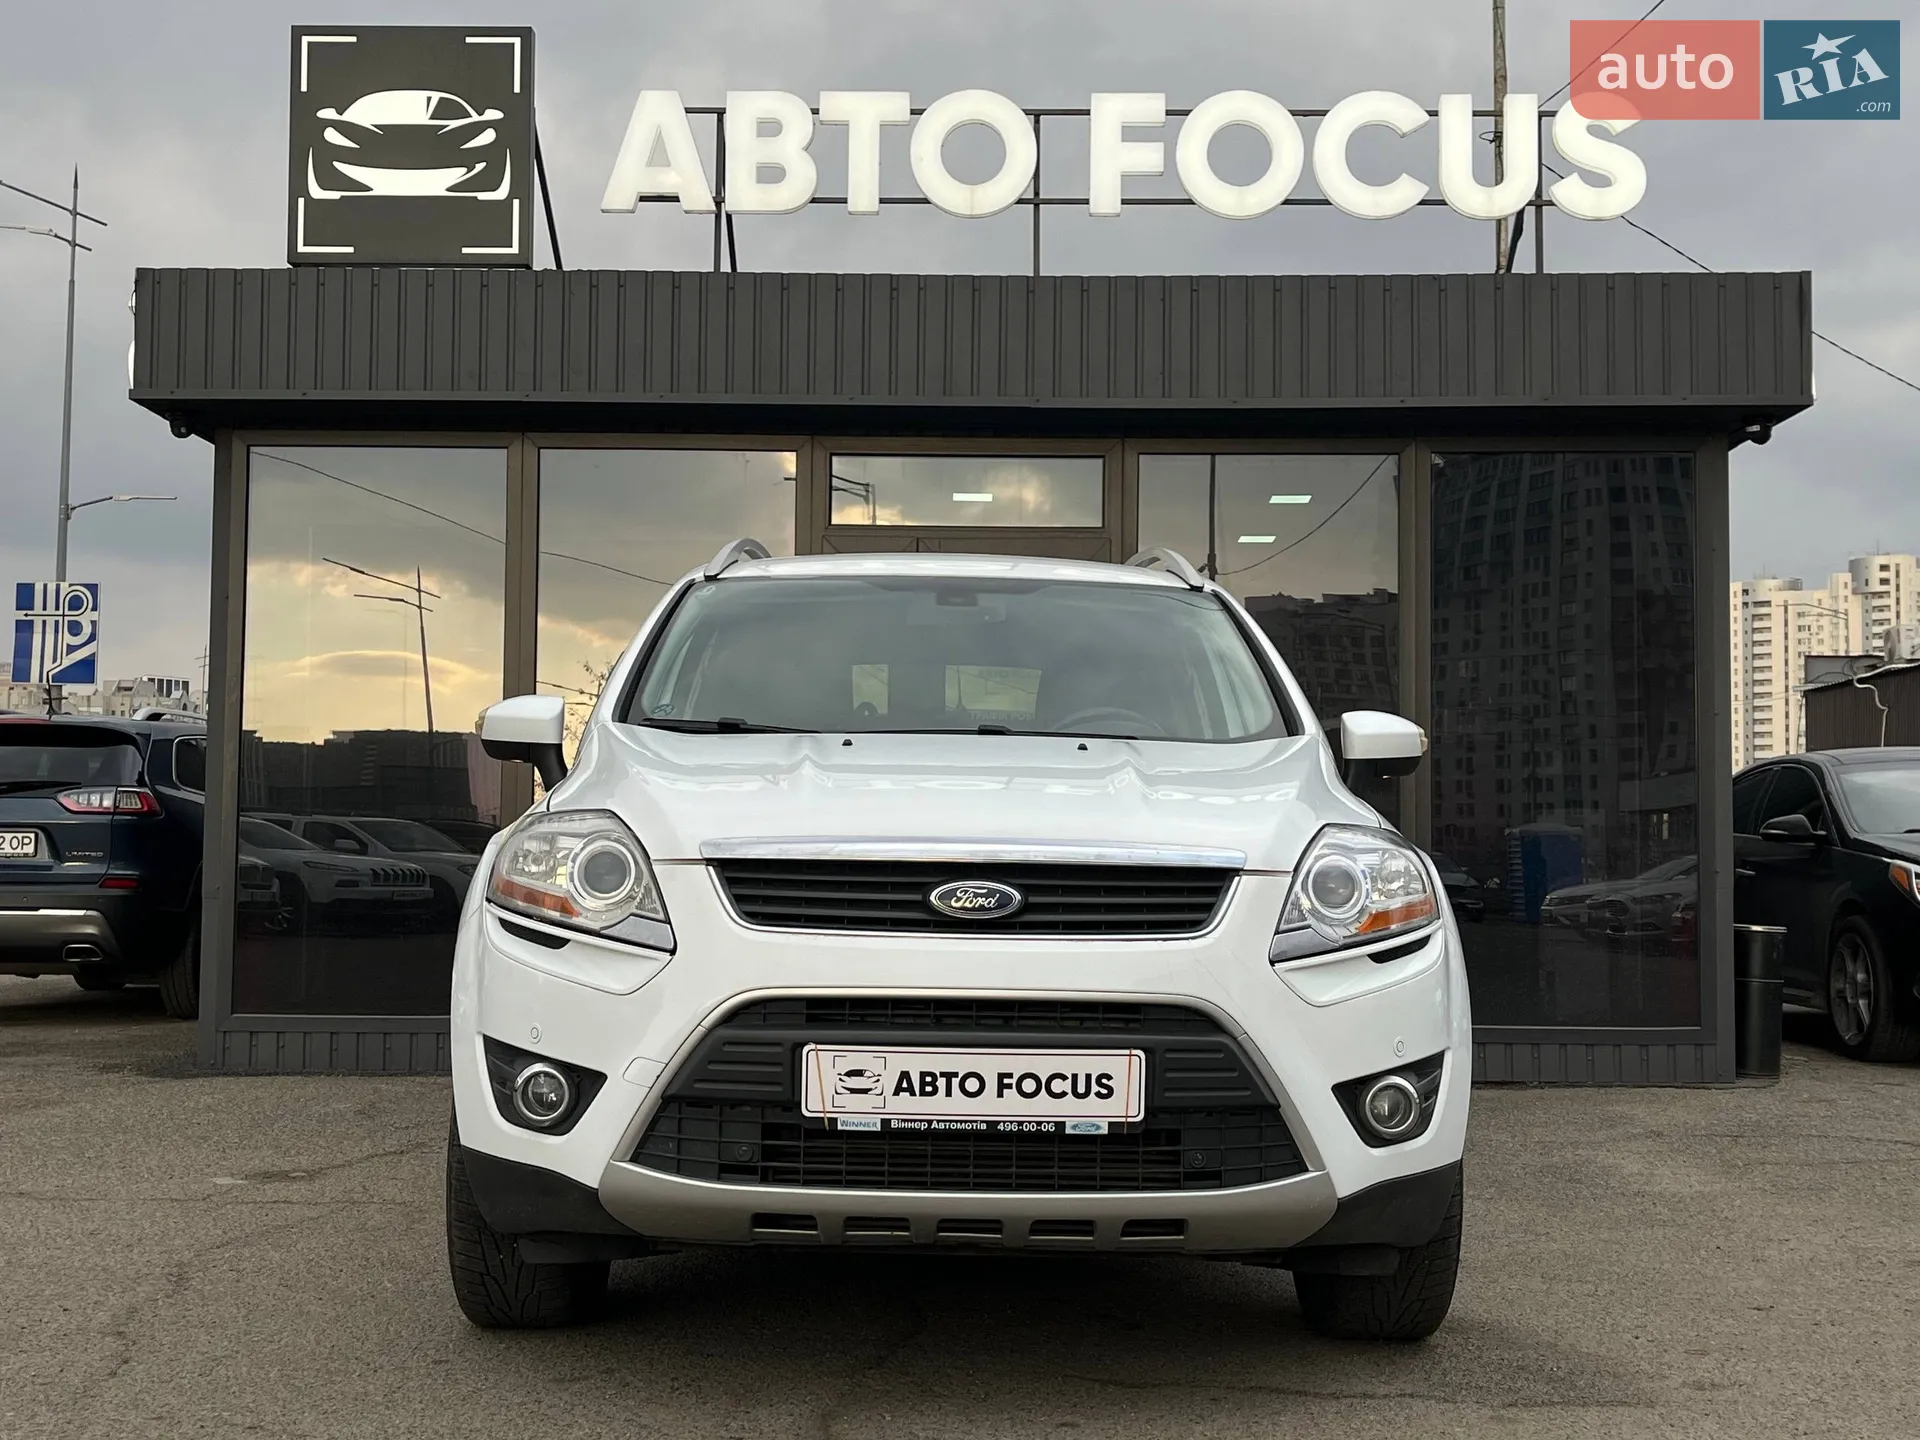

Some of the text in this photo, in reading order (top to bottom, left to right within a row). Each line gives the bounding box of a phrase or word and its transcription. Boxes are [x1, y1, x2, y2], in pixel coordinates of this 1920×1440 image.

[600, 89, 1648, 221] АВТО FOCUS
[950, 887, 1000, 909] Ford
[892, 1070, 1115, 1101] АВТО FOCUS
[839, 1119, 879, 1130] WINNER
[890, 1119, 1056, 1132] Віннер Автомотів 496-00-06
